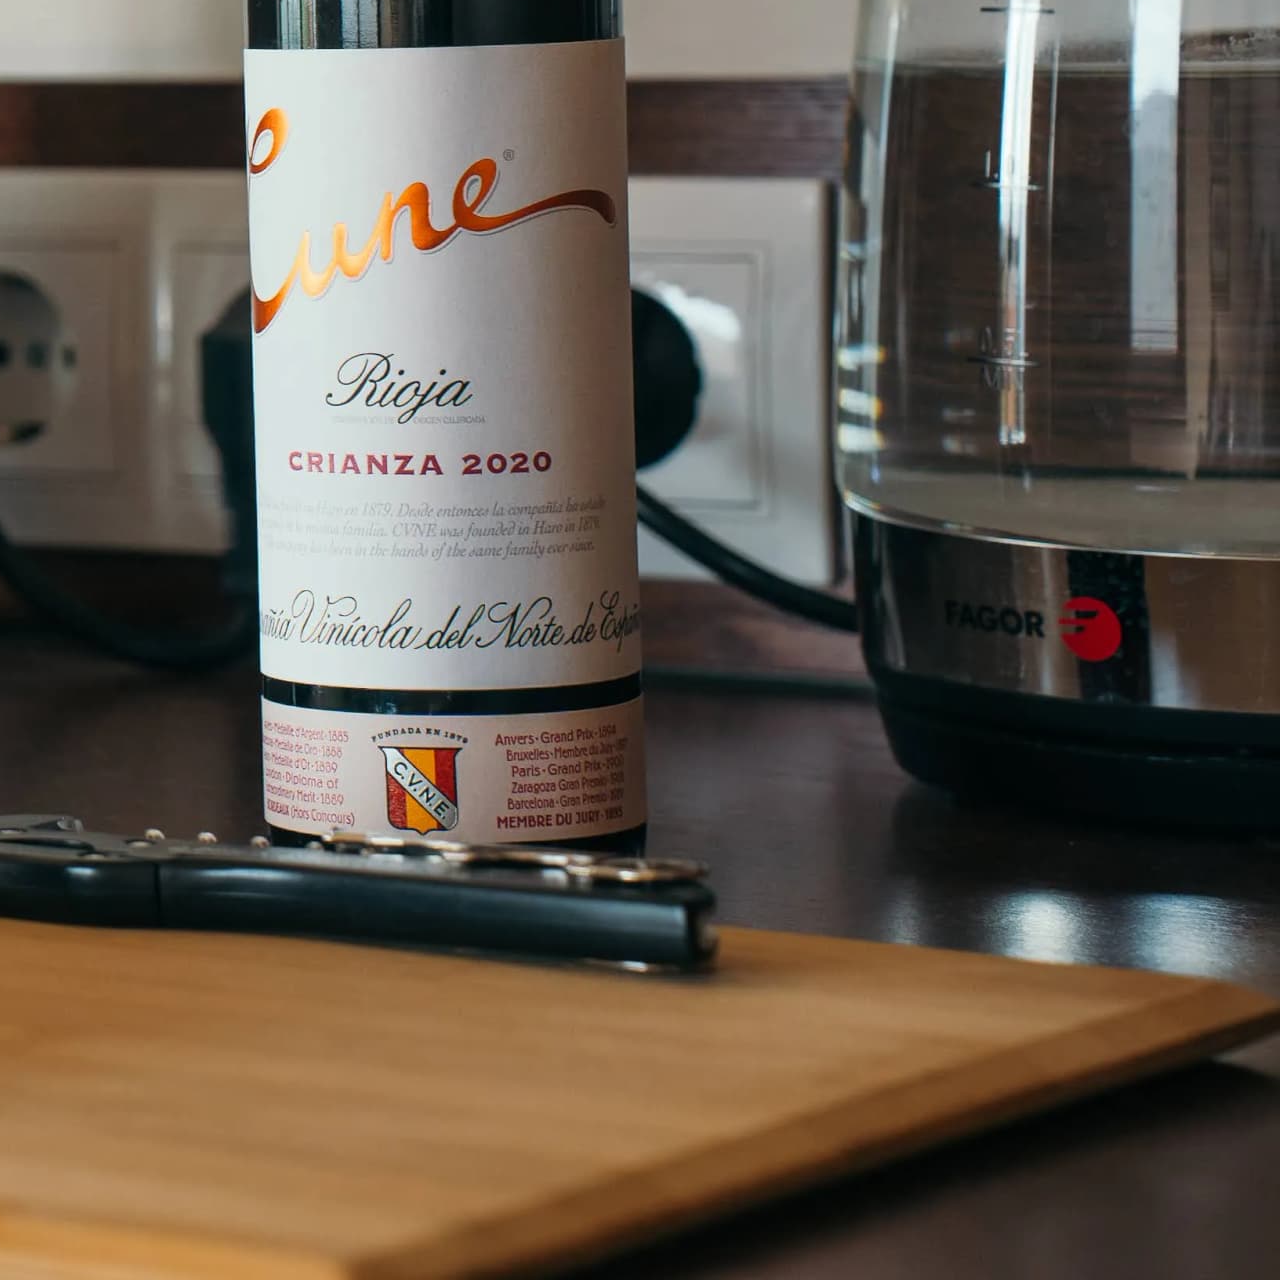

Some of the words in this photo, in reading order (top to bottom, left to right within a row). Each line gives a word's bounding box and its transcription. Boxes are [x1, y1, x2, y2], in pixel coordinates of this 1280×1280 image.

[326, 352, 473, 424] Rioja
[288, 451, 444, 476] CRIANZA
[461, 451, 553, 476] 2020
[395, 502, 435, 518] Desde
[437, 505, 489, 518] entonces
[492, 502, 504, 517] la
[392, 523, 438, 537] CVNE
[440, 526, 465, 537] was
[464, 522, 516, 541] founded
[518, 524, 529, 536] in
[533, 521, 562, 536] Haro
[432, 542, 447, 560] of
[448, 542, 467, 557] the
[468, 545, 502, 558] same
[503, 540, 545, 560] family
[291, 589, 422, 649] Vinícola
[415, 603, 474, 649] del
[475, 596, 563, 648] Norte
[564, 601, 597, 645] de
[944, 600, 1045, 638] FAGOR
[328, 731, 349, 743] 1885
[371, 728, 422, 742] FUNDADA
[426, 728, 441, 736] EN
[495, 734, 535, 746] Anvers
[541, 730, 574, 744] Grand
[507, 749, 550, 761] Bruxelles
[555, 747, 588, 759] Membre
[512, 766, 541, 777] Paris
[549, 763, 581, 775] Grand
[285, 773, 323, 788] Diploma
[326, 779, 339, 789] of
[512, 782, 556, 794] Zaragoza
[559, 780, 581, 791] Gran
[297, 791, 316, 803] Merit
[508, 798, 555, 810] Barcelona
[560, 795, 581, 807] Gran
[311, 809, 355, 827] Concours)
[497, 814, 552, 829] MEMBRE
[556, 813, 572, 826] DU
[576, 811, 600, 824] JURY
